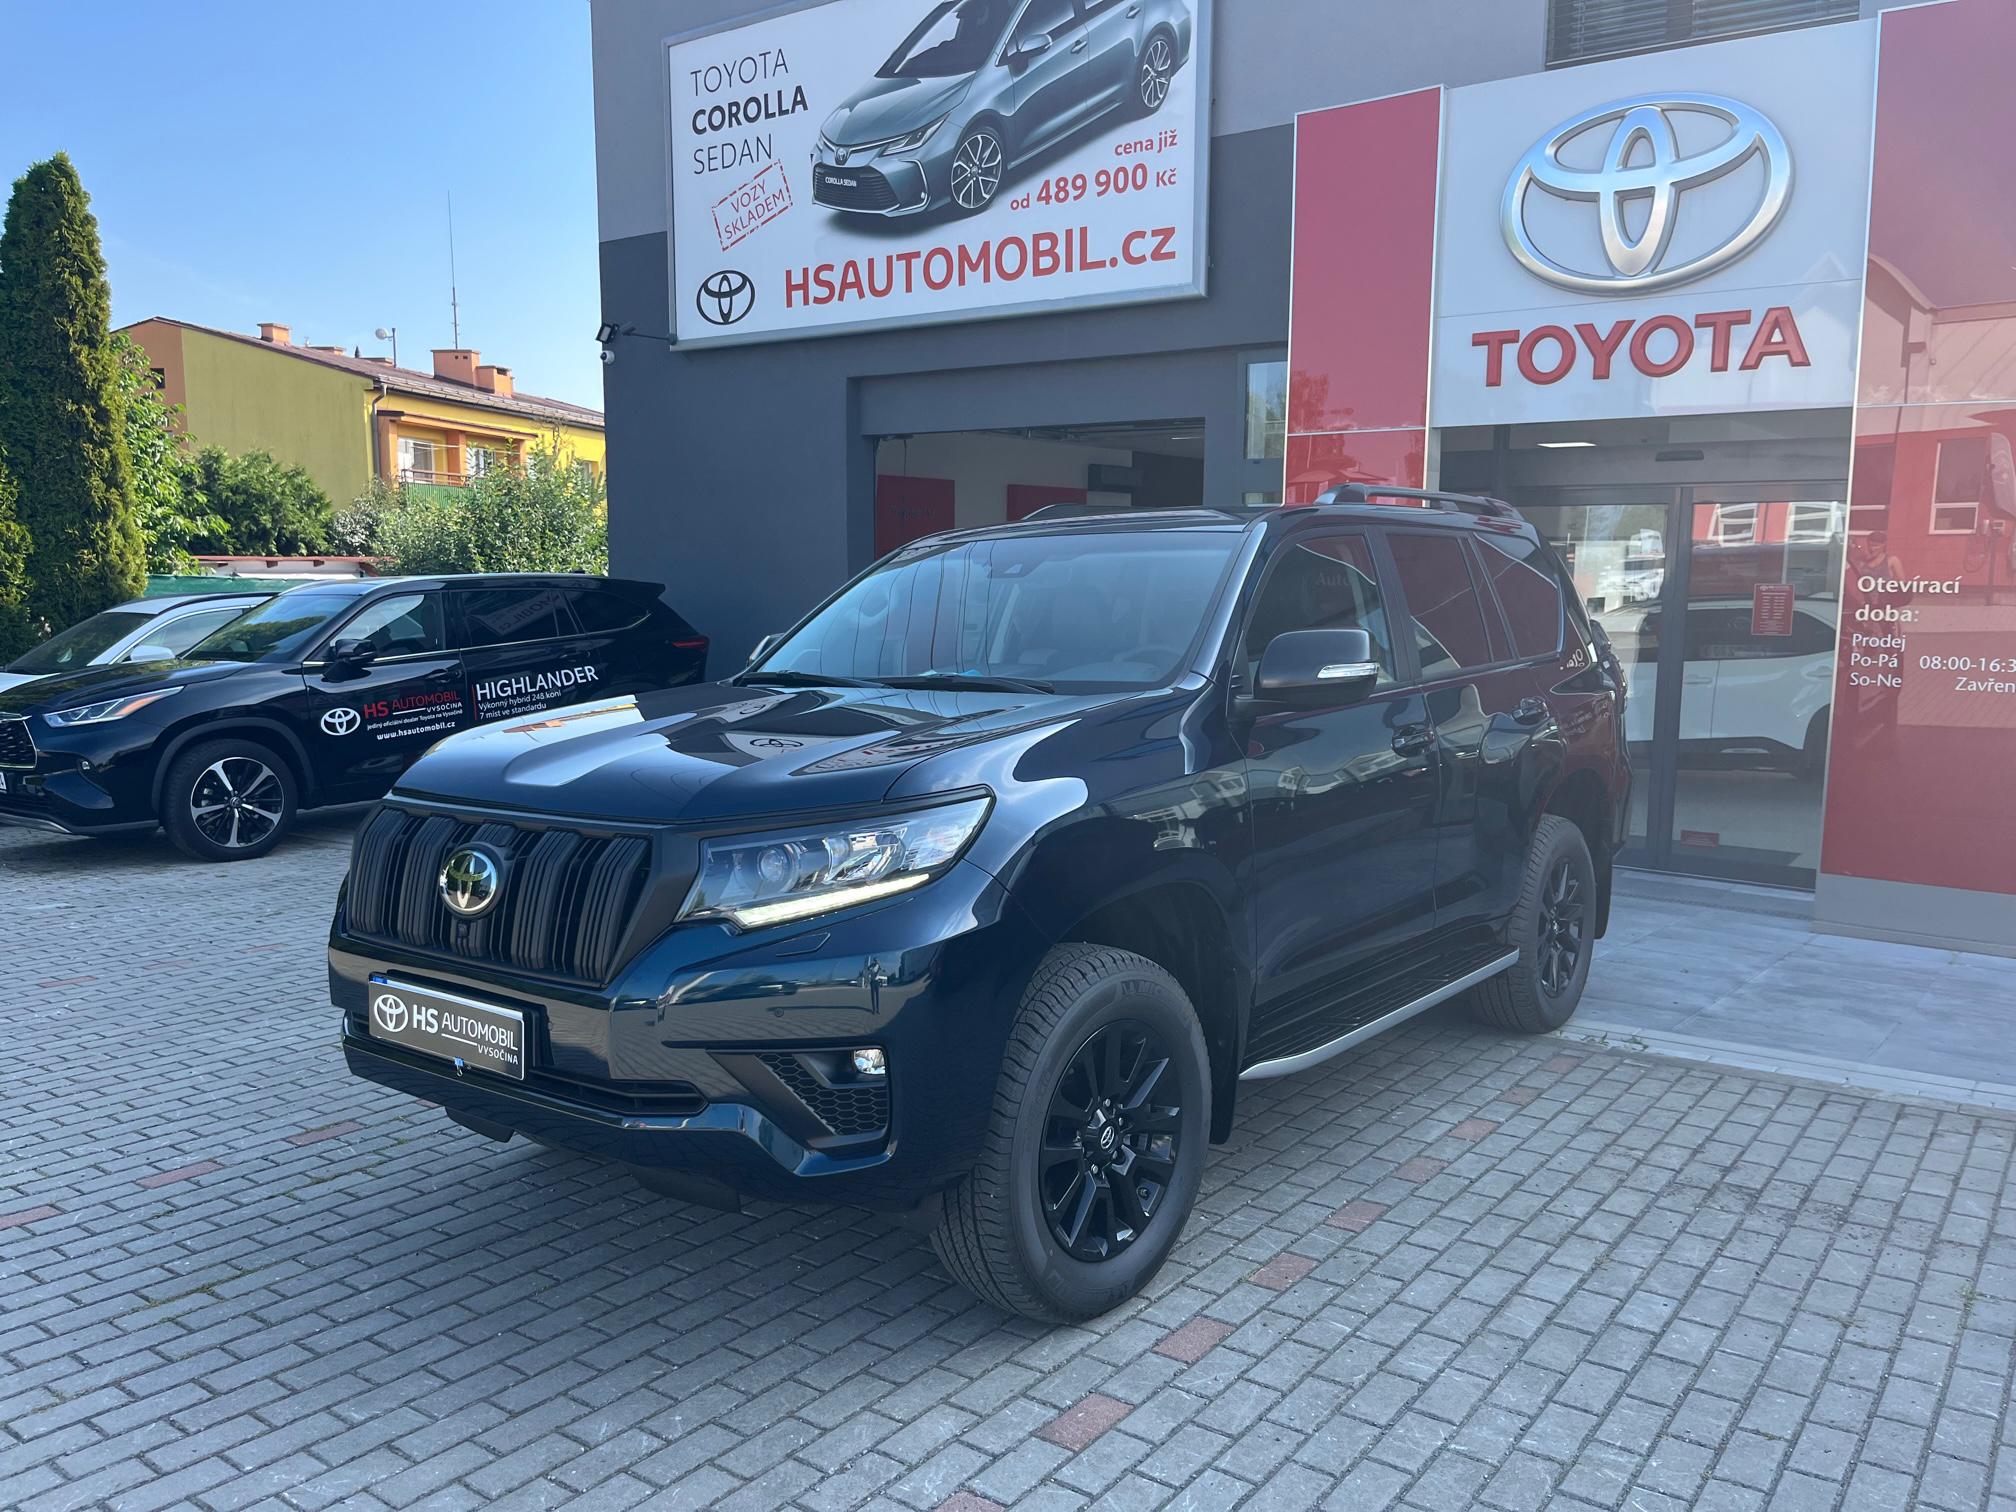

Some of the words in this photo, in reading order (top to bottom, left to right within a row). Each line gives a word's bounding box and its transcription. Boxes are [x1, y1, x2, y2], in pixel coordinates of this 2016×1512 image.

[690, 48, 789, 97] TOYOTA
[692, 85, 809, 135] COROLLA
[693, 133, 772, 175] SEDAN
[1114, 137, 1154, 156] cena
[1157, 129, 1178, 153] již
[825, 176, 843, 186] COROLLA
[843, 179, 857, 188] SEDAN
[1010, 192, 1030, 211] od
[1036, 173, 1088, 206] 489
[1094, 163, 1148, 198] 900
[1156, 168, 1177, 188] Kč
[730, 179, 767, 214] VOZY
[724, 189, 786, 240] SKLADEM
[1471, 306, 1811, 388] TOYOTA
[1857, 575, 1963, 594] Otevírací
[1855, 604, 1920, 622] doba:
[1852, 633, 1907, 652] Prodej
[1850, 653, 1899, 668] Po-Pá
[1919, 655, 2016, 673] 08:00-16:3
[476, 665, 599, 701] HIGHLANDER
[1850, 672, 1902, 688] So-Ne
[1955, 676, 2016, 694] Zavřen
[363, 700, 389, 720] HS
[392, 690, 461, 710] AUTOMOBIL
[426, 701, 463, 714] VYSOČINA
[478, 699, 509, 712] Výkonný
[509, 695, 531, 706] hybrid
[511, 703, 547, 714] standardu
[420, 712, 436, 721] Toyota
[376, 721, 456, 740] www.hsautomobil.cz
[413, 1004, 439, 1034] HS
[441, 1012, 518, 1051] AUTOMOBIL
[477, 1043, 519, 1066] VYSOČINA
